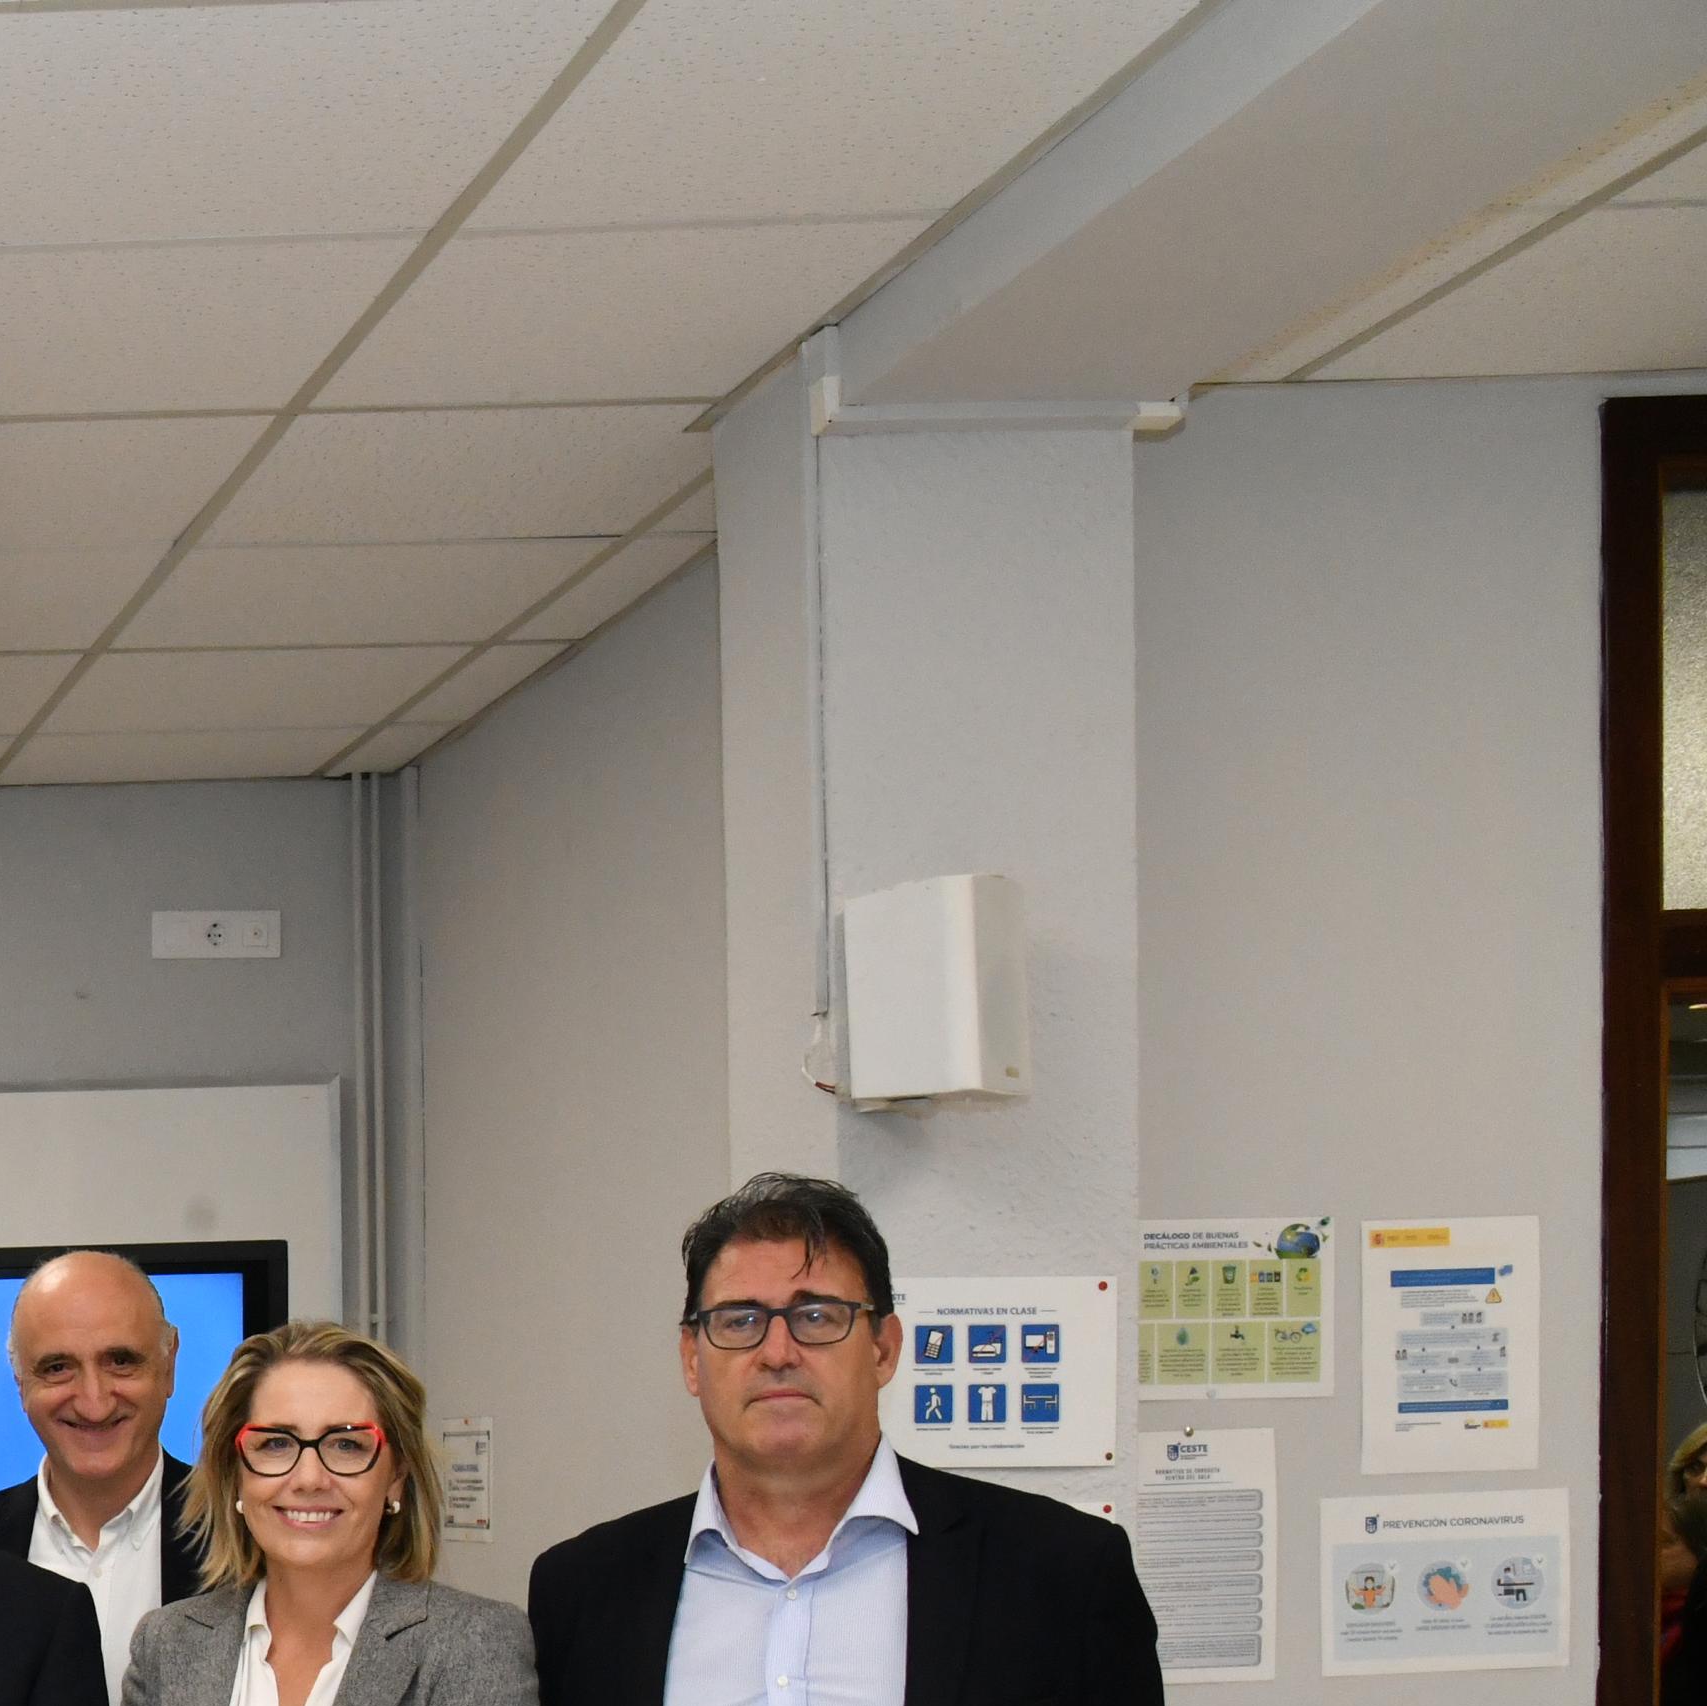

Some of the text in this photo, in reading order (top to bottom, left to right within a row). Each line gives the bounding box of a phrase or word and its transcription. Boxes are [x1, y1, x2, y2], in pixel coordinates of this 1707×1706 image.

[1192, 1231, 1203, 1240] DE
[1205, 1230, 1239, 1240] BUENAS
[1143, 1240, 1249, 1250] PRÁCTICAS AMBIENTALES
[937, 1306, 1037, 1318] NORMATIVAS EN CLASE
[1180, 1444, 1208, 1453] CESTE
[1383, 1515, 1524, 1529] PREVENCIÓN CORONAVIRUS
